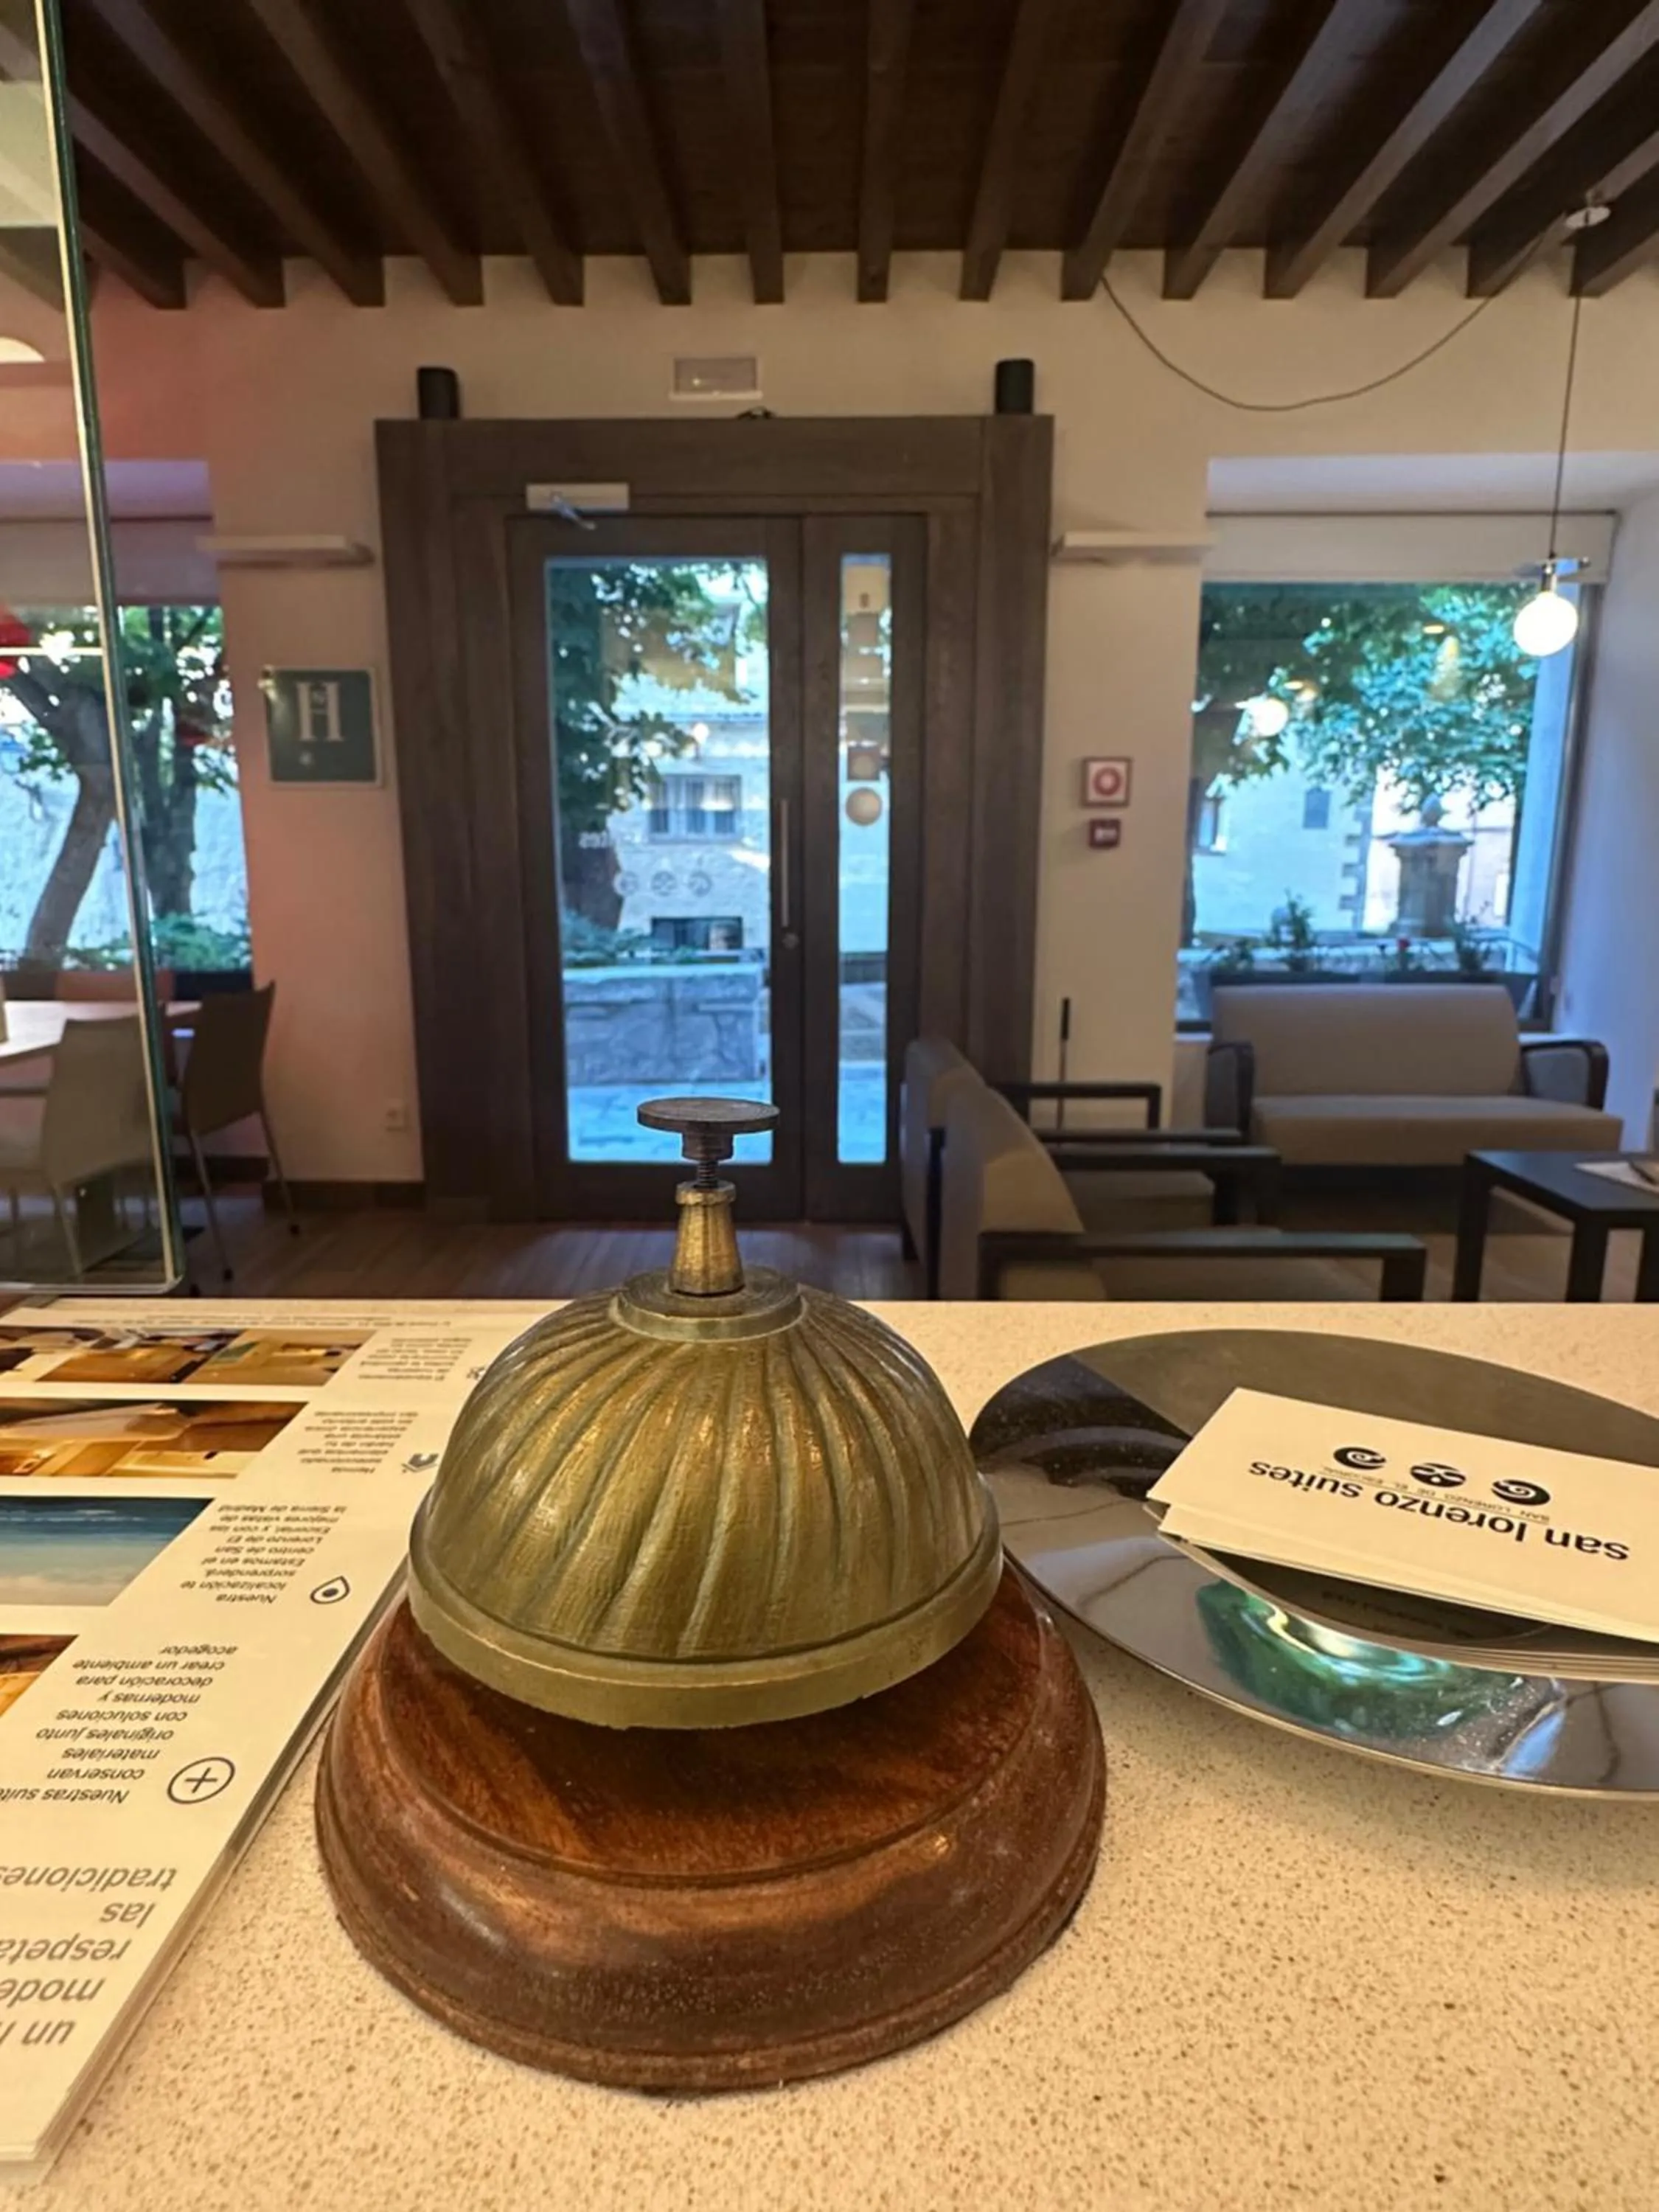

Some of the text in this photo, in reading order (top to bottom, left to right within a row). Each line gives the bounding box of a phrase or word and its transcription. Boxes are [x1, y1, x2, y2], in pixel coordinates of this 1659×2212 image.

[296, 681, 344, 742] H
[1248, 1461, 1630, 1561] san lorenzo suites
[201, 1557, 217, 1565] el
[243, 1558, 305, 1567] Estamos
[179, 1580, 288, 1591] localización te
[215, 1594, 276, 1604] Nuestra
[159, 1644, 238, 1655] acogedor
[73, 1659, 225, 1671] crear un ambiente
[76, 1674, 213, 1688] decoración para
[97, 1690, 201, 1705] modernas y
[56, 1710, 188, 1722] con soluciones
[35, 1727, 174, 1742] originales junto
[61, 1748, 160, 1761] materiales
[46, 1768, 145, 1781] conservan
[43, 1788, 131, 1804] Nuestras
[99, 1902, 156, 1929] las
[21, 2020, 76, 2046] un
